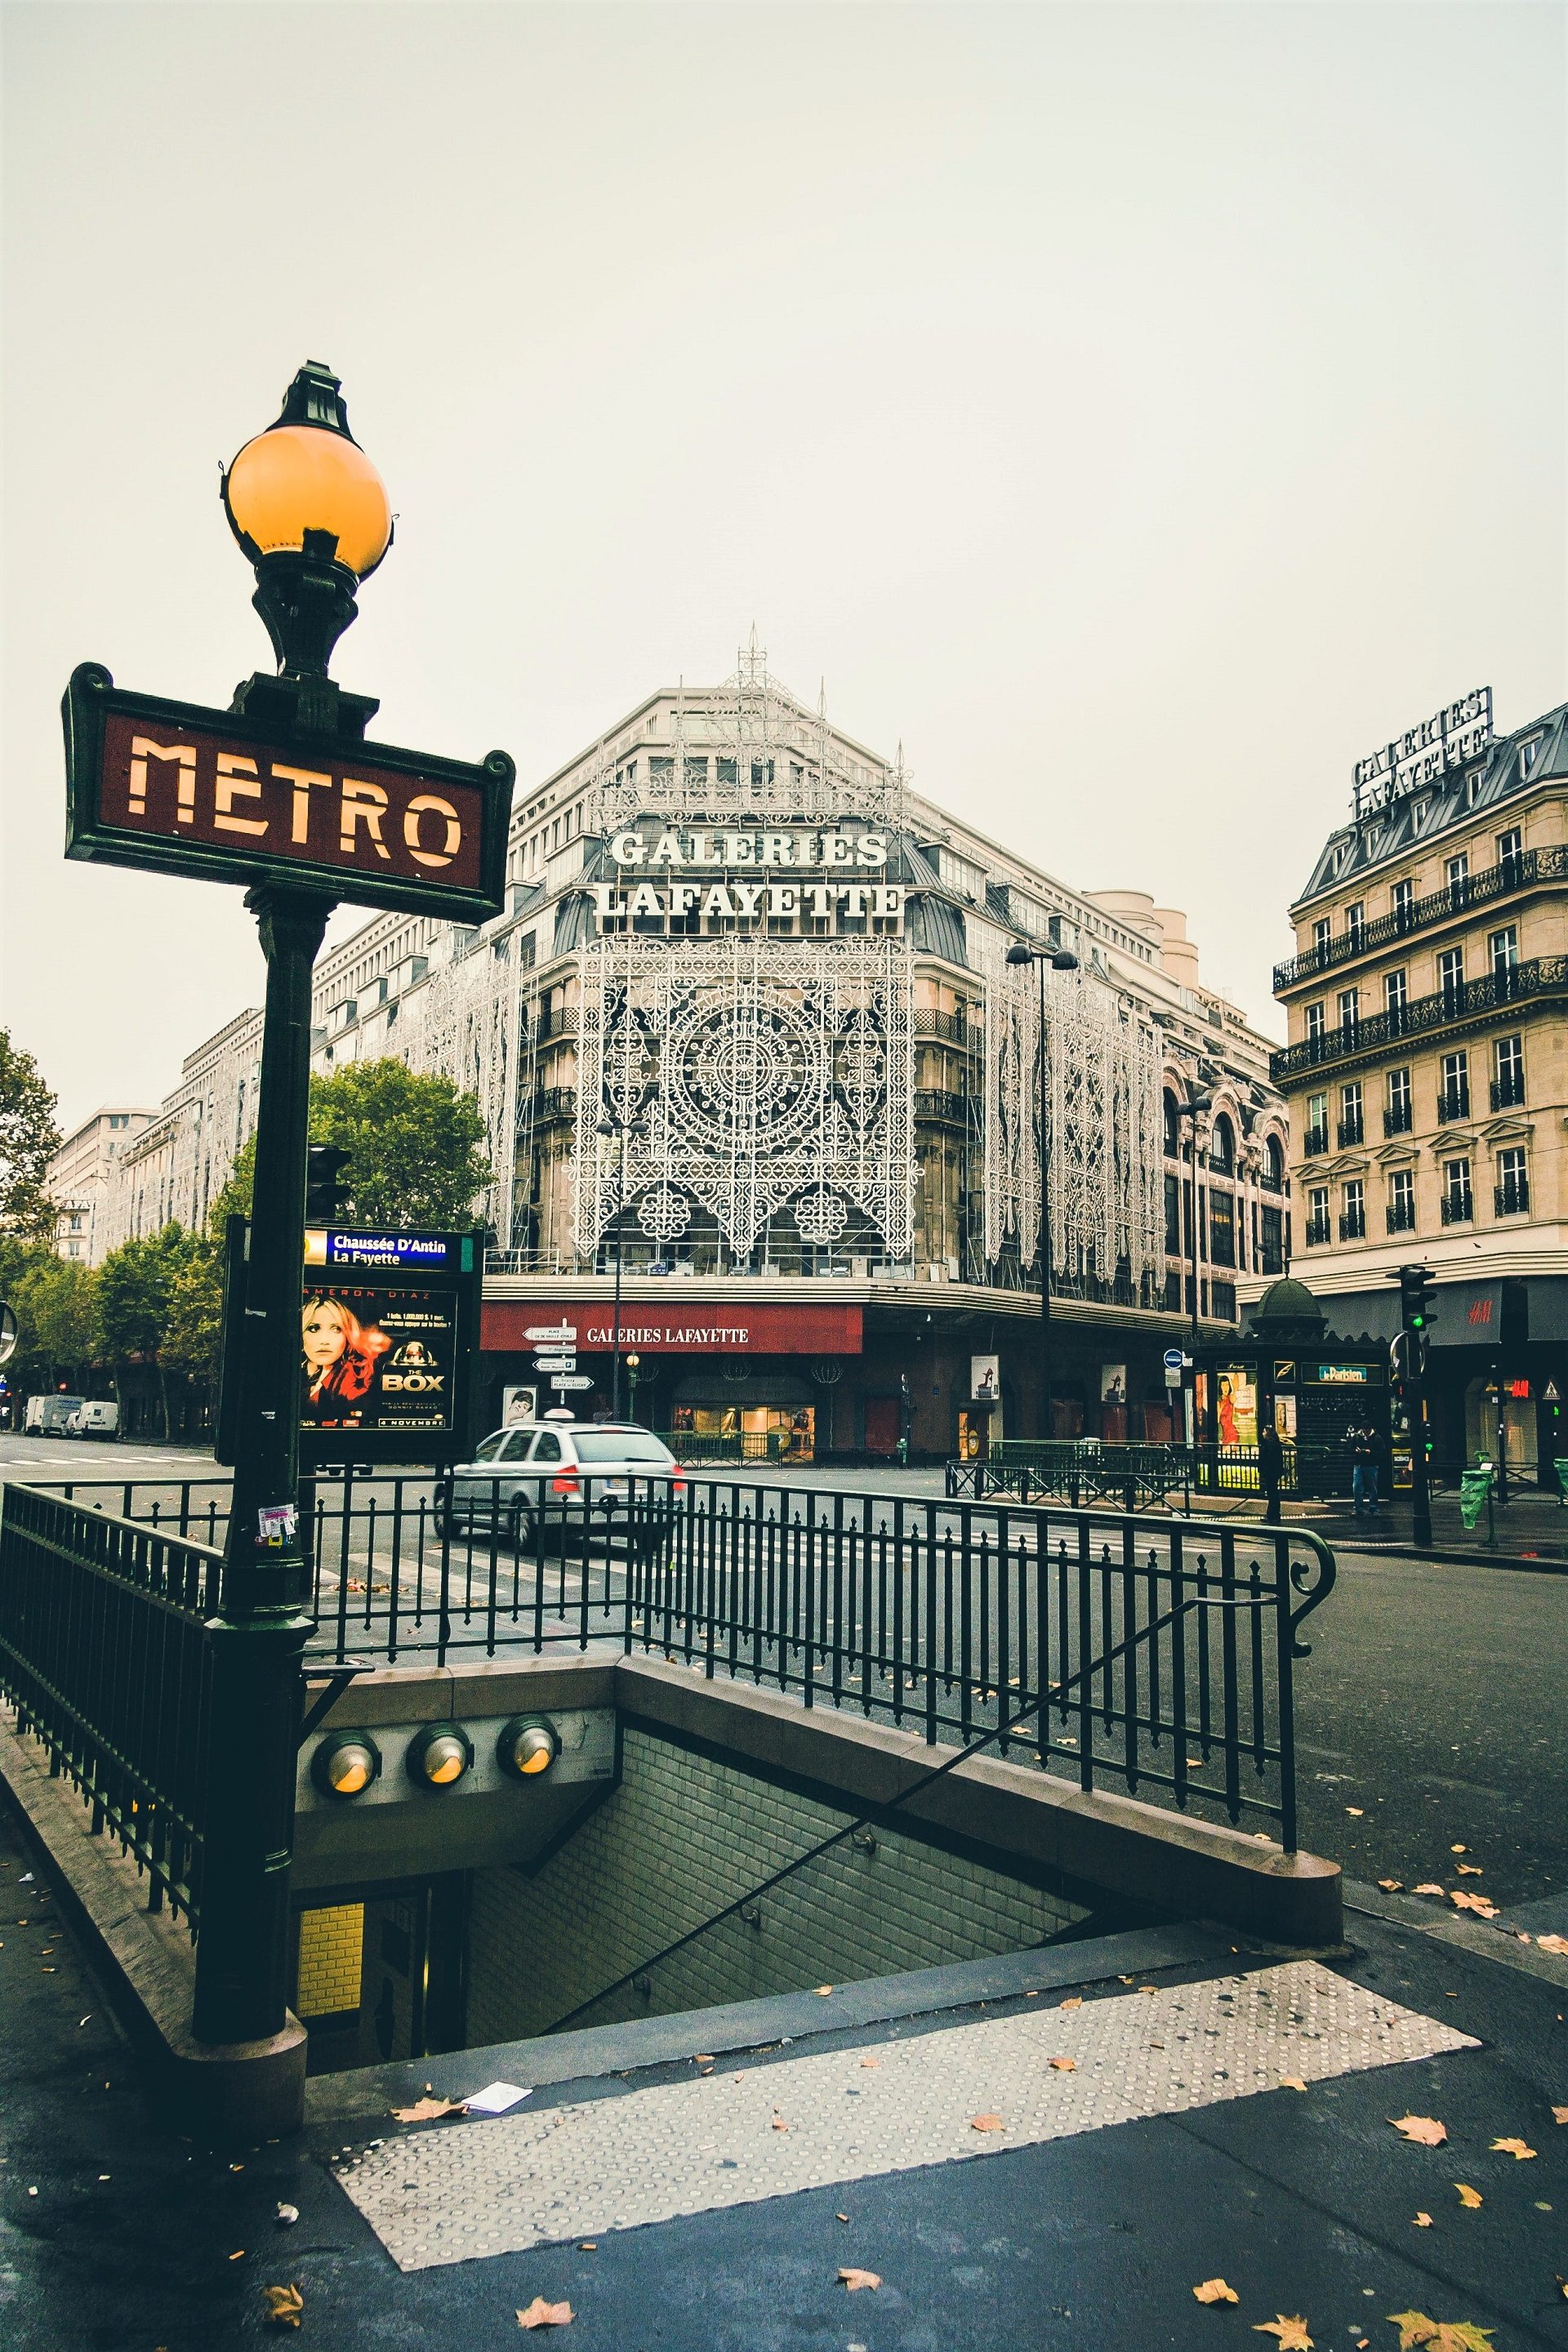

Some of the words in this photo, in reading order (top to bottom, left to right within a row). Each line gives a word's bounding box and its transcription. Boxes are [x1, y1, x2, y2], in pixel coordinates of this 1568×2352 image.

[1351, 688, 1481, 789] GALERIES
[1349, 725, 1486, 822] LAFAYETTE
[128, 736, 461, 867] METRO
[612, 831, 888, 866] GALERIES
[592, 883, 906, 917] LAFAYETTE
[334, 1236, 394, 1250] Chaussée
[334, 1250, 349, 1263] La
[353, 1251, 400, 1266] Fayette
[302, 1289, 375, 1297] AMERON
[389, 1291, 430, 1299] DIAZ
[586, 1328, 662, 1343] GALERIES
[665, 1329, 749, 1343] LAFAYETTE
[1329, 1366, 1362, 1381] Parisien
[381, 1374, 445, 1392] BOX
